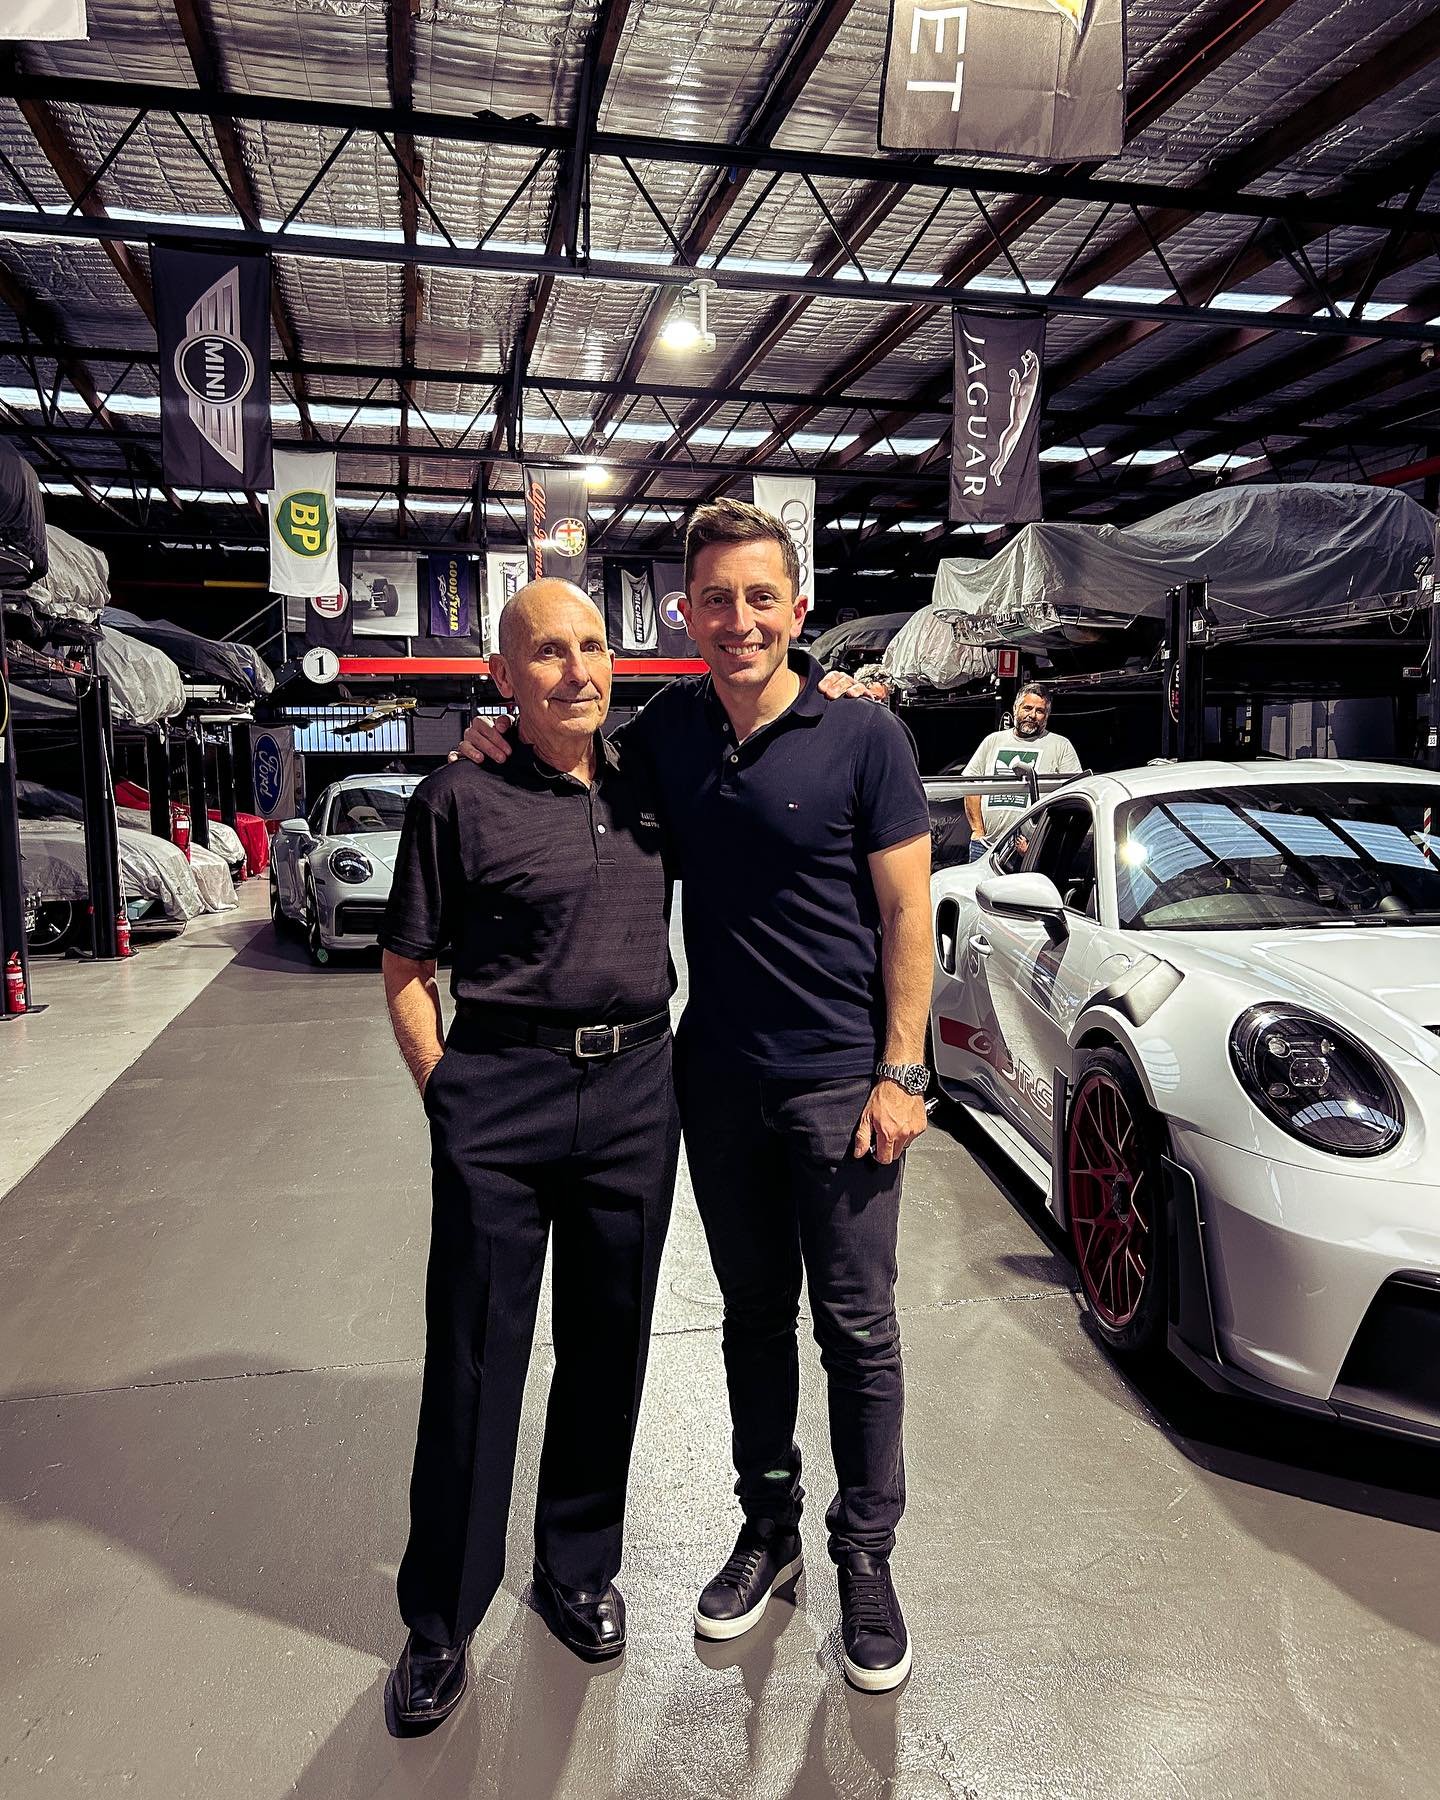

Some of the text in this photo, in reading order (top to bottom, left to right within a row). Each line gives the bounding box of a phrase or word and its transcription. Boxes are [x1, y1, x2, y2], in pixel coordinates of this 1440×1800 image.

[906, 7, 967, 112] ET
[204, 342, 226, 398] MINI
[963, 329, 989, 496] JAGUAR
[290, 500, 320, 551] BP
[526, 482, 546, 526] Alfa
[447, 560, 461, 632] GOODYEAR
[634, 592, 644, 641] MICHELIN
[314, 655, 328, 677] 1
[259, 750, 279, 798] Ford
